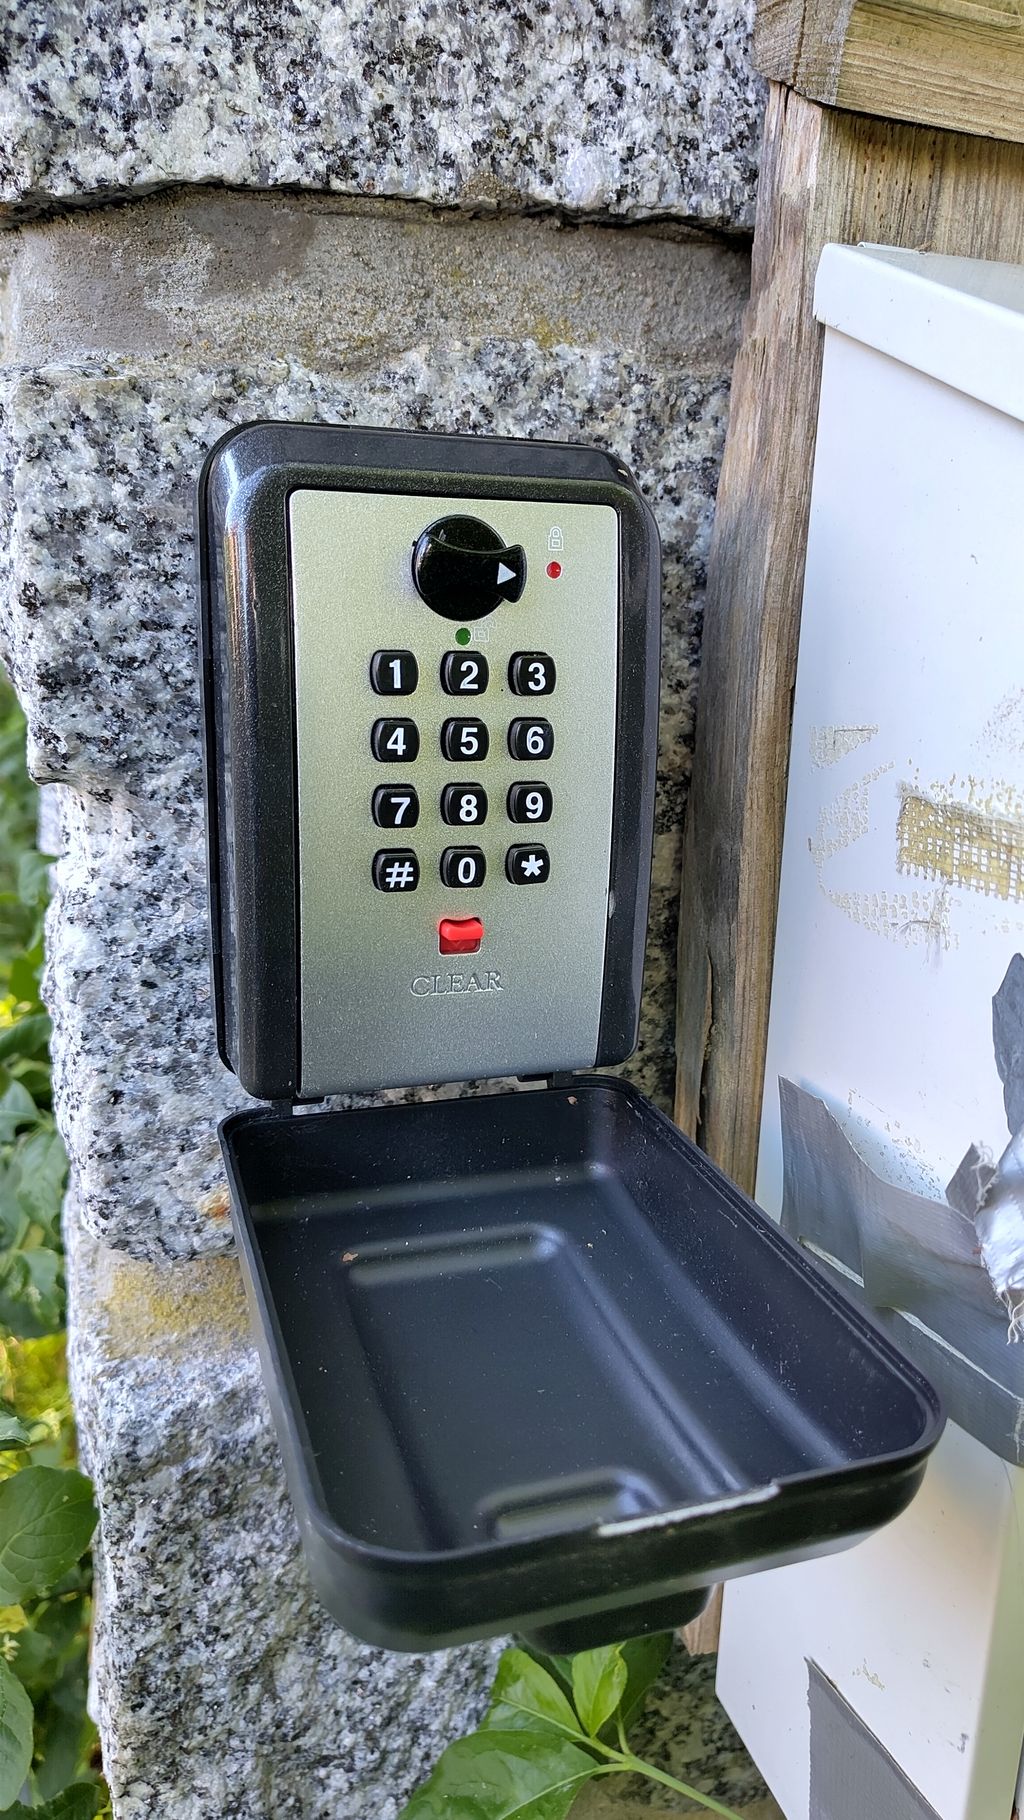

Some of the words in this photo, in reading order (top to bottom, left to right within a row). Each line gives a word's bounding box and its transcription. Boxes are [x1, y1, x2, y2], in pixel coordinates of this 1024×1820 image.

[390, 659, 401, 688] 1
[460, 661, 478, 689] 2
[529, 663, 545, 690] 3
[387, 728, 406, 755] 4
[461, 728, 478, 754] 5
[527, 727, 543, 754] 6
[391, 798, 410, 824] 7
[460, 795, 477, 821] 8
[526, 792, 543, 818] 9
[386, 862, 413, 888] #
[458, 857, 475, 883] 0
[410, 970, 503, 997] CLEAR
